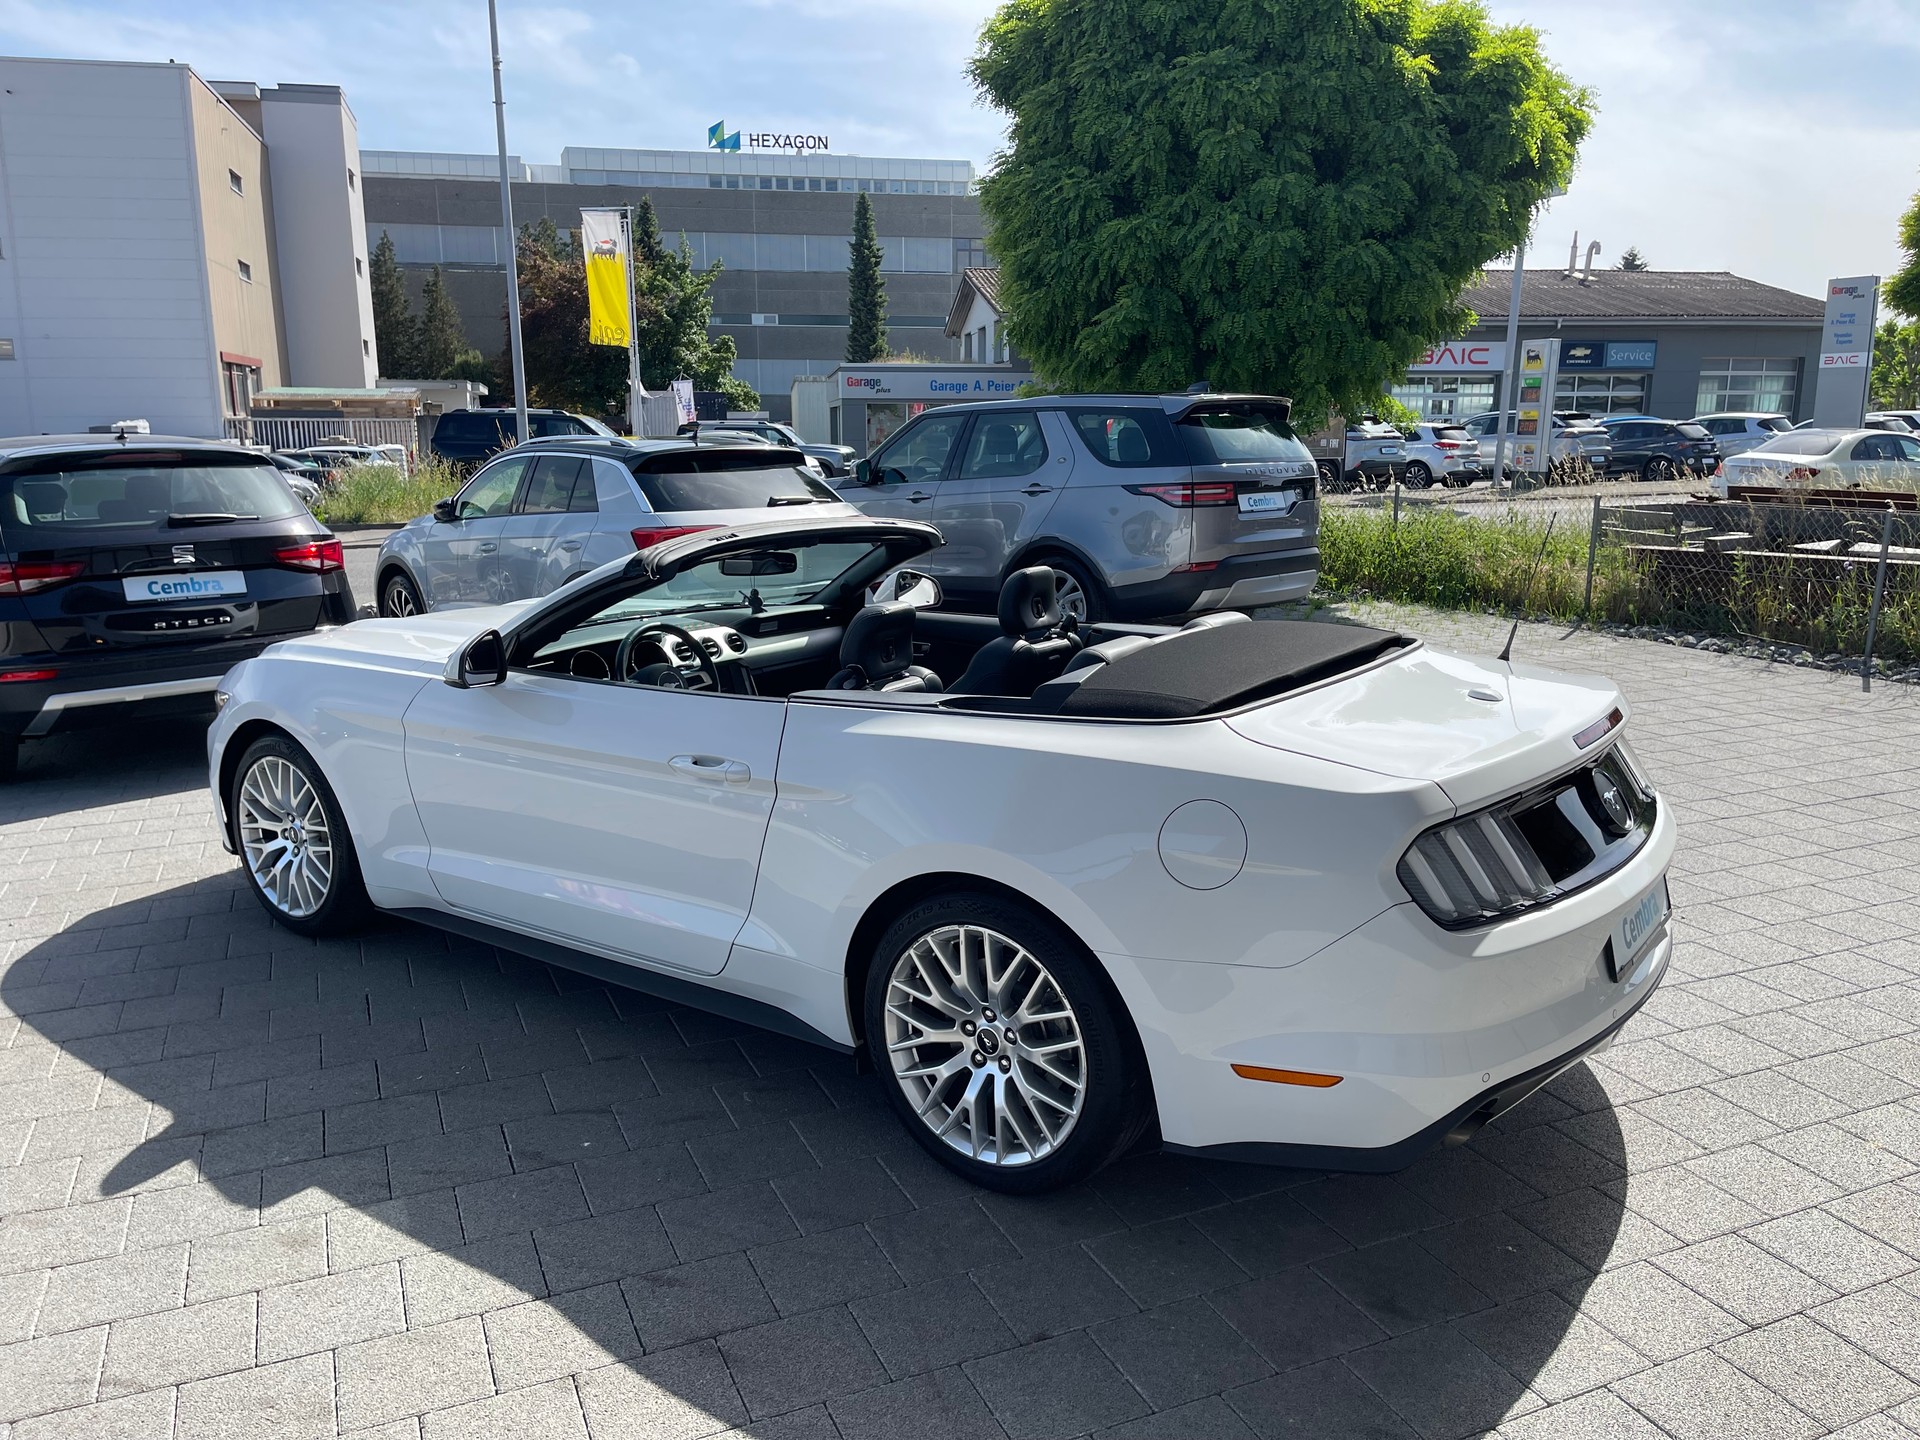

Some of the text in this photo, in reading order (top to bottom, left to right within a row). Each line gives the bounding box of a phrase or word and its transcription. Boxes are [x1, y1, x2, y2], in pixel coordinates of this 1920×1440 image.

[749, 133, 828, 149] HEXAGON
[1831, 286, 1858, 296] Garage
[1611, 349, 1652, 360] Service
[1824, 355, 1859, 365] BAIC
[847, 376, 881, 389] Garage
[930, 379, 968, 393] Garage
[974, 380, 984, 391] A.
[988, 380, 1015, 391] Peier
[1247, 494, 1277, 507] Cembra
[147, 577, 224, 595] Cembra
[154, 616, 231, 629] ATECA
[1622, 892, 1660, 950] Cembra
